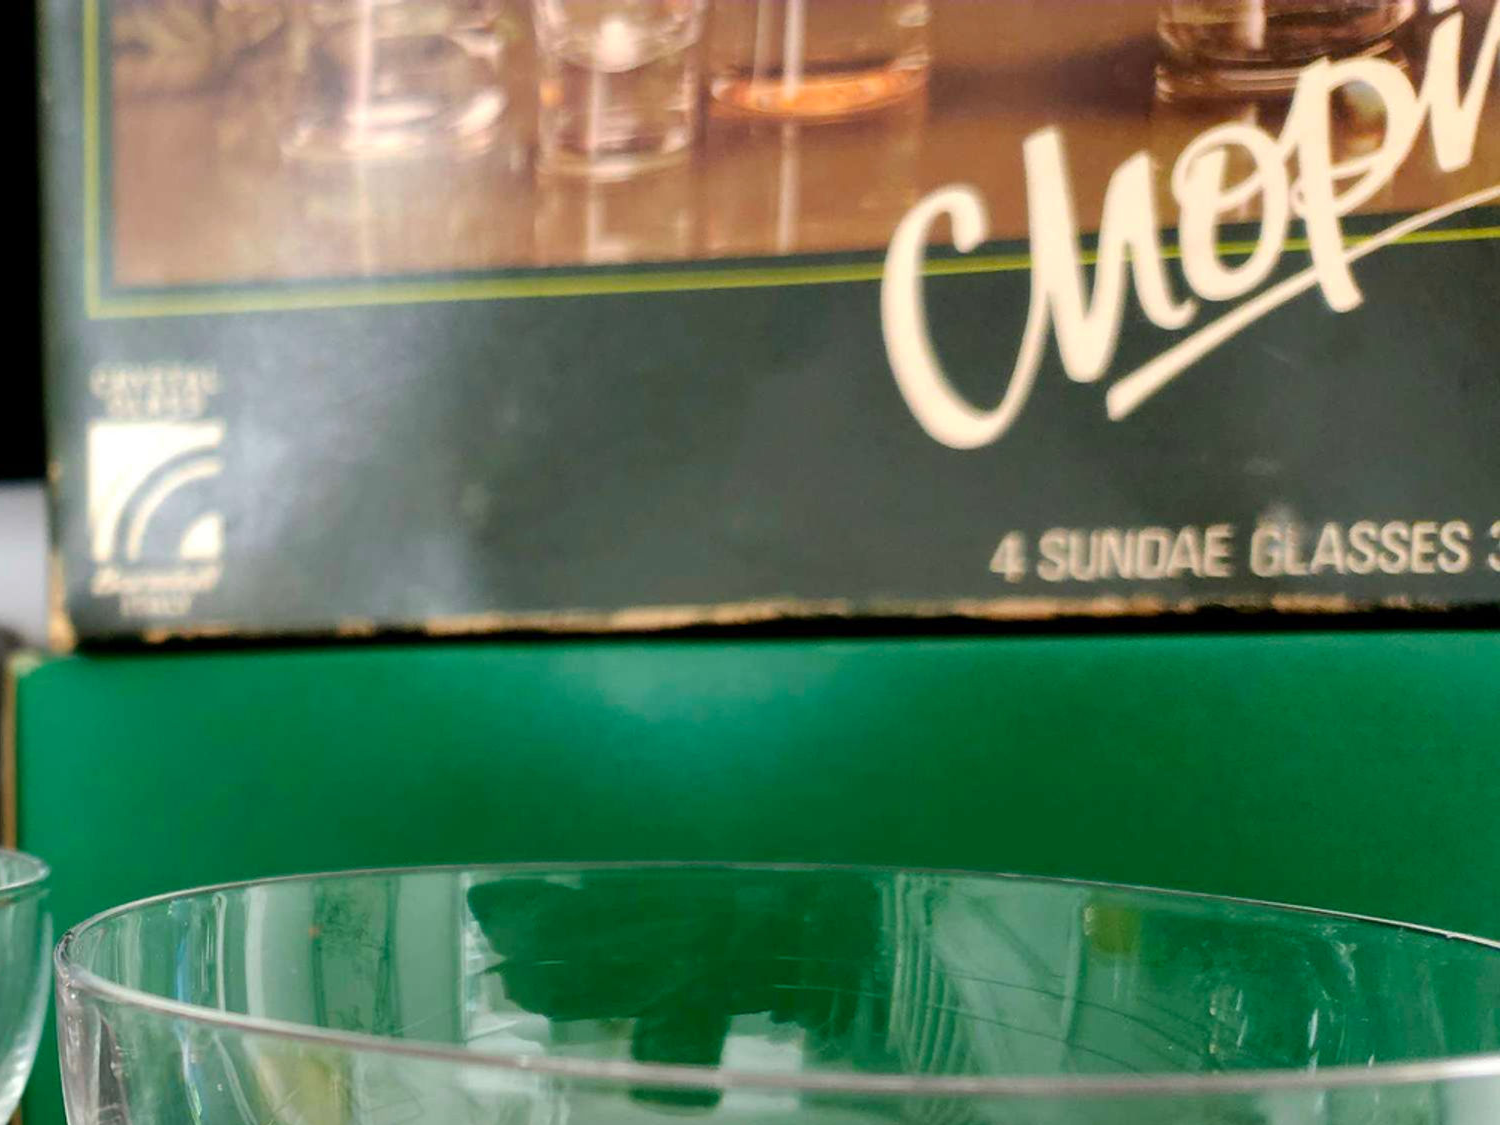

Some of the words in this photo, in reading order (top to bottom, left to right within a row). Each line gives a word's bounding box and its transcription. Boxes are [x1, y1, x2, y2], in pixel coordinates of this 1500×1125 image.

[989, 531, 1025, 582] 4
[1036, 524, 1233, 581] SUNDAE
[1250, 520, 1470, 577] GLASSES
